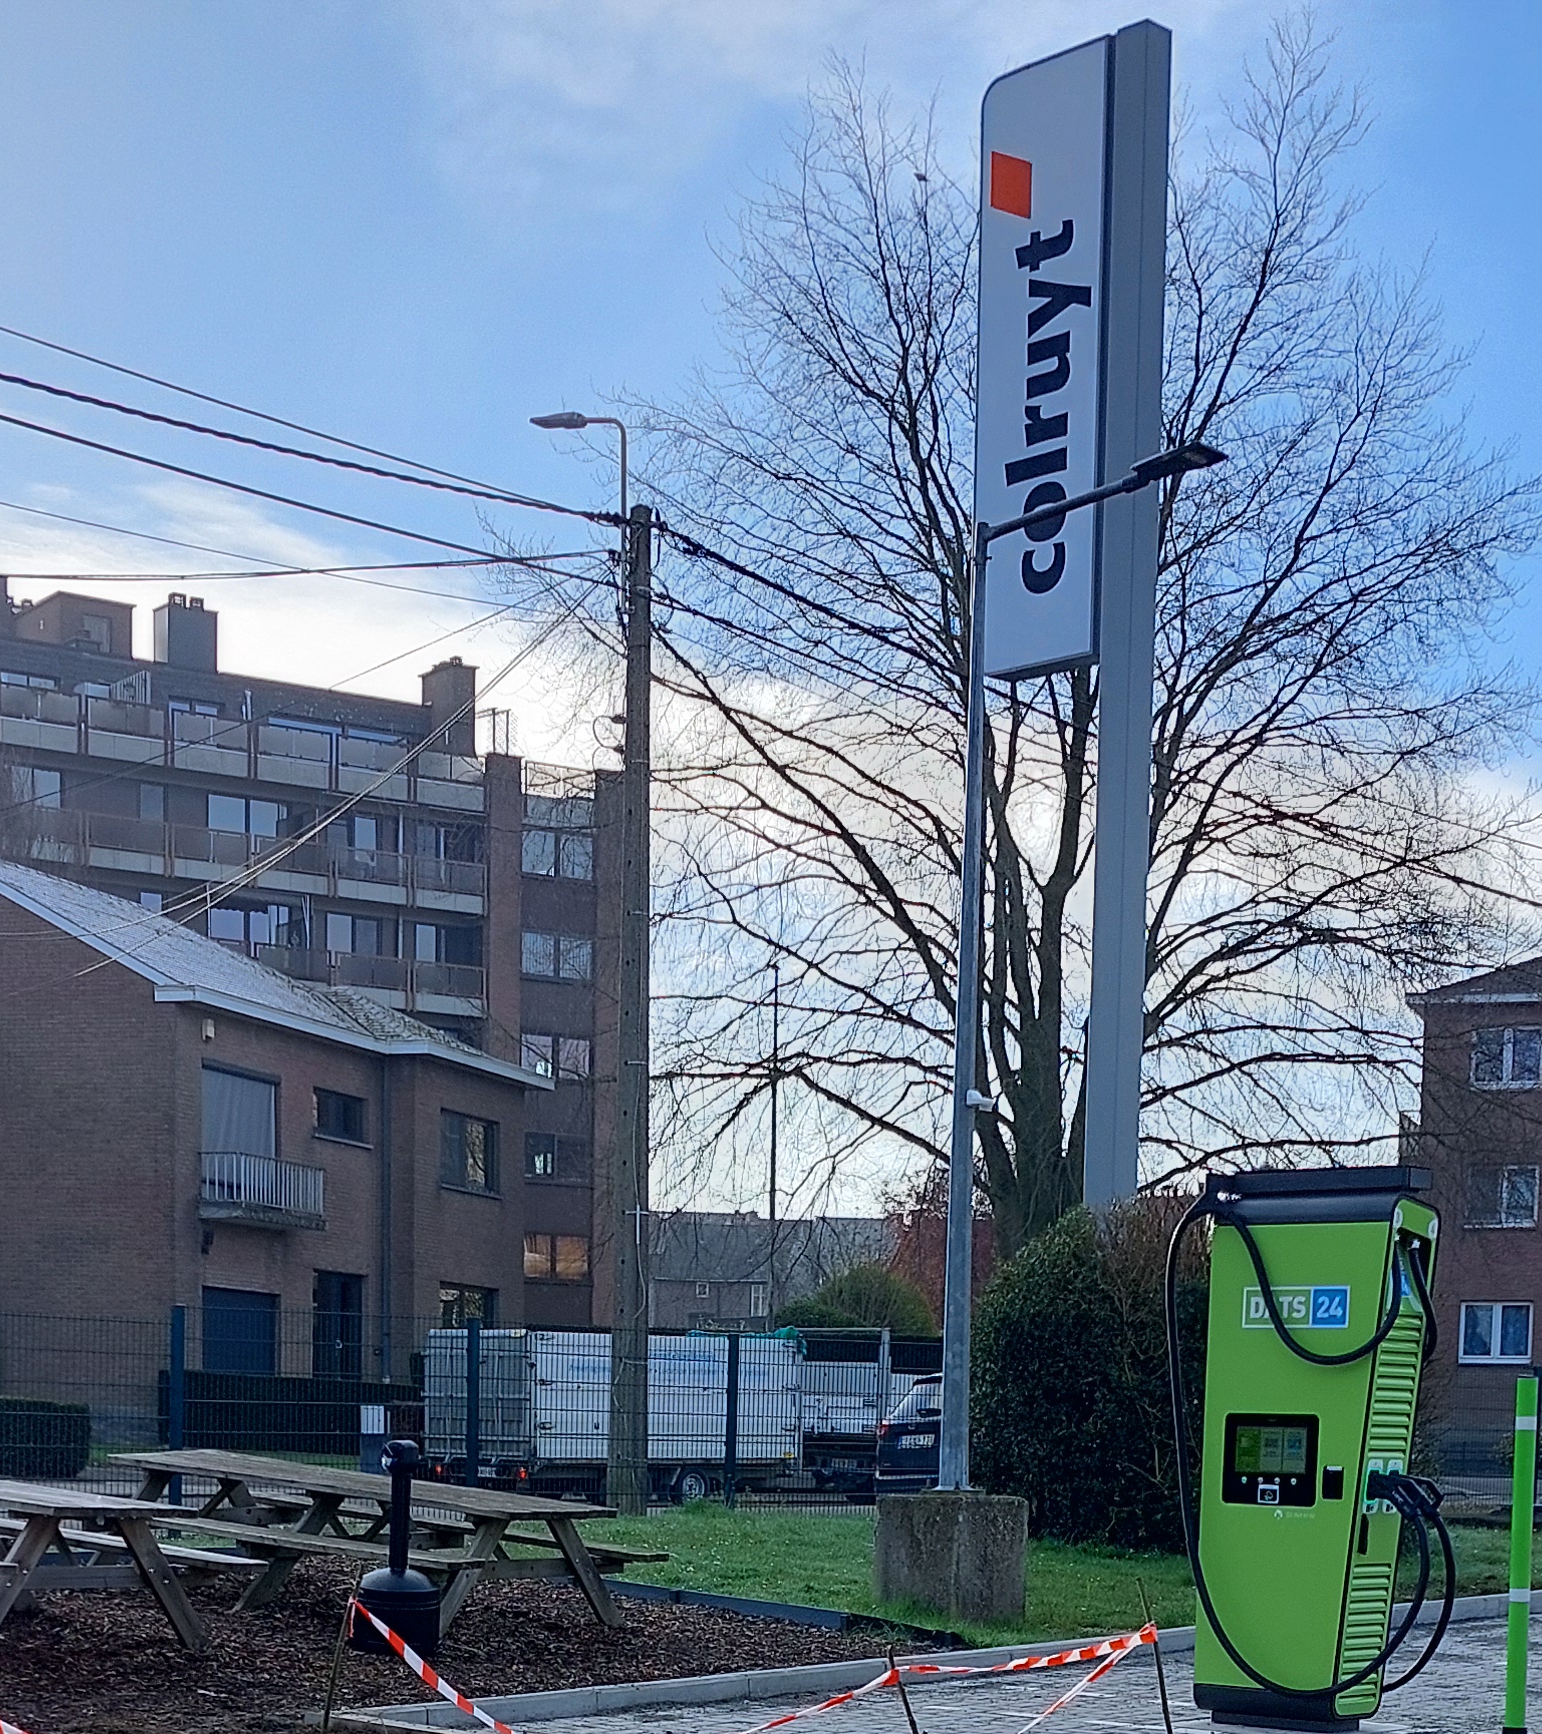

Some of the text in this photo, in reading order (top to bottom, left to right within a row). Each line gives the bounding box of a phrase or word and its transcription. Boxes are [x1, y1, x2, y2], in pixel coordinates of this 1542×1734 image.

[1005, 218, 1092, 596] colruyt
[1249, 1295, 1343, 1319] DTS 24
